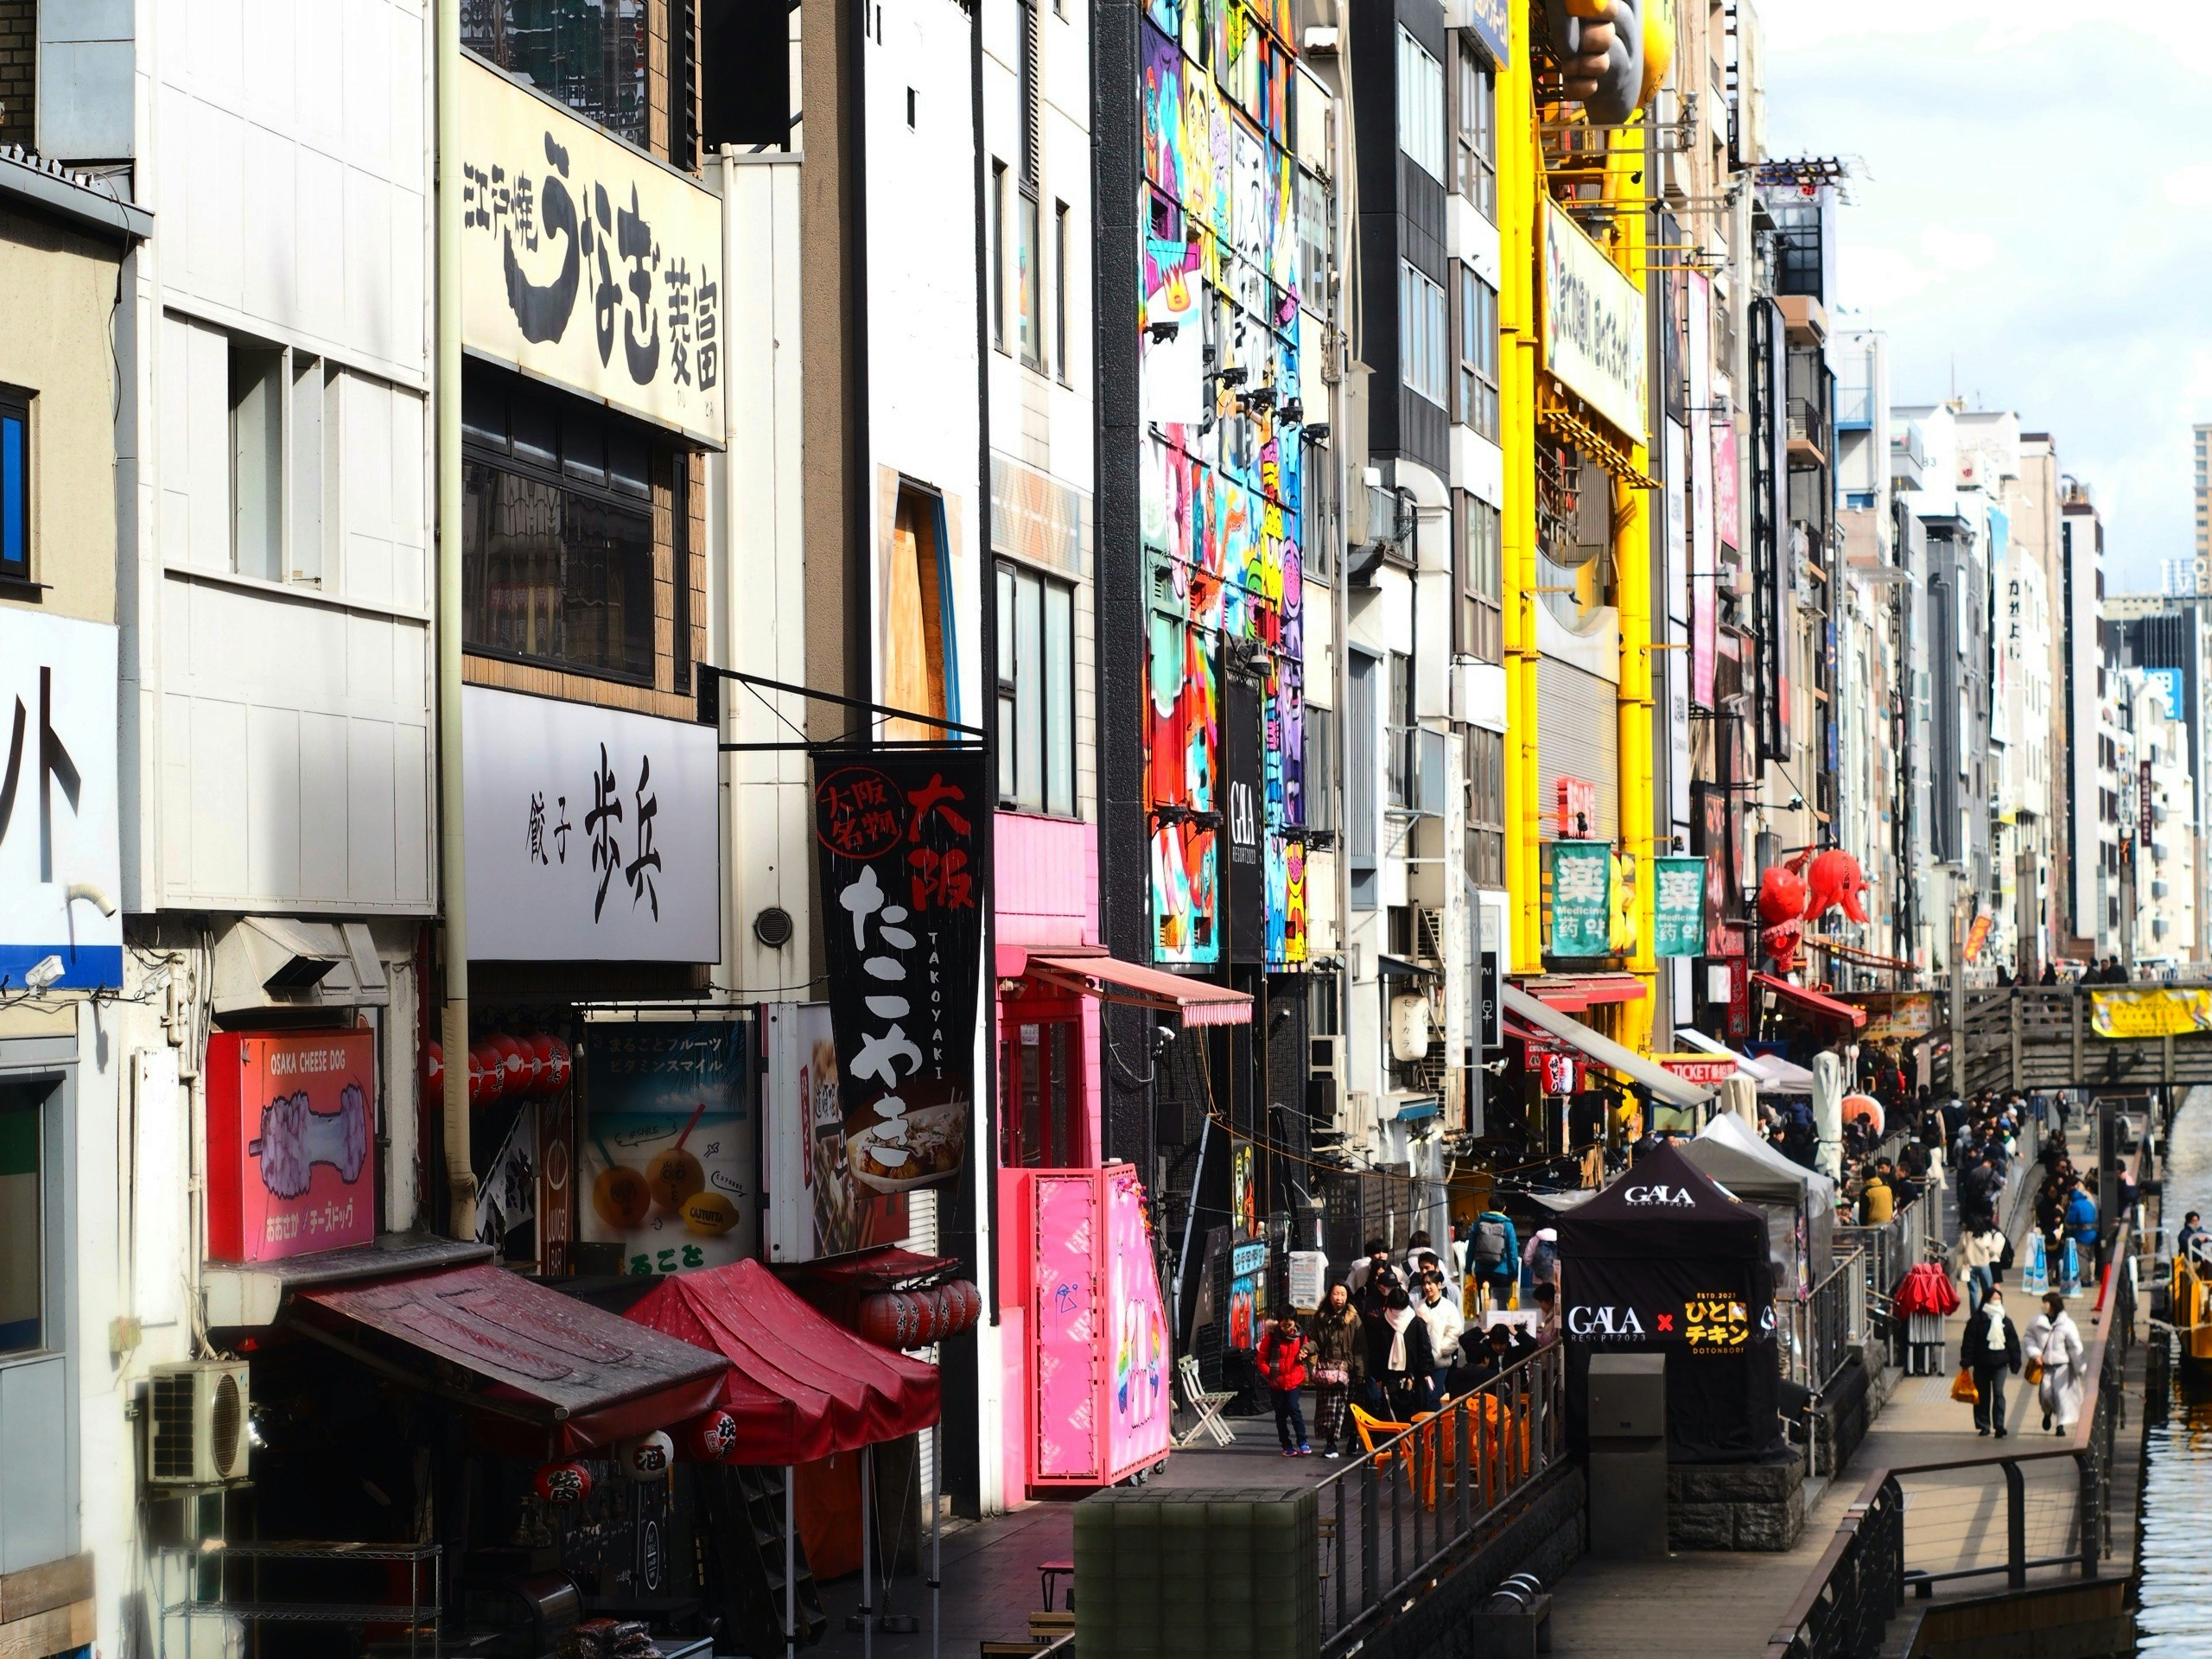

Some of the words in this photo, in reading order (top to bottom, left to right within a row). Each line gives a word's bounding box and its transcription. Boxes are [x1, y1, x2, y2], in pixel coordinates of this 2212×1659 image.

[821, 777, 888, 819] 大阪
[1230, 780, 1255, 845] GALA
[525, 791, 572, 866] 餃子
[585, 741, 662, 925] 歩兵
[907, 773, 976, 912] 大阪
[1558, 856, 1605, 903] 薬
[1659, 871, 1699, 911] 薬
[1557, 906, 1605, 915] Medicine
[1657, 913, 1700, 922] Medicine
[839, 863, 923, 1169] たこやき
[927, 931, 944, 1080] TAKOYAKI
[270, 1052, 297, 1076] OSAKA
[299, 1050, 328, 1073] CHEESE
[330, 1049, 346, 1071] DOG
[608, 1038, 722, 1053] まるごとフルーツ
[611, 1059, 723, 1074] ビタミンスマイル
[1672, 1064, 1711, 1080] TICKET
[1624, 1185, 1694, 1204] GALA
[266, 1212, 300, 1243] おおさか
[310, 1197, 353, 1235] チーズドッグ
[1568, 1306, 1646, 1335] GALA
[1685, 1325, 1750, 1345] チキン
